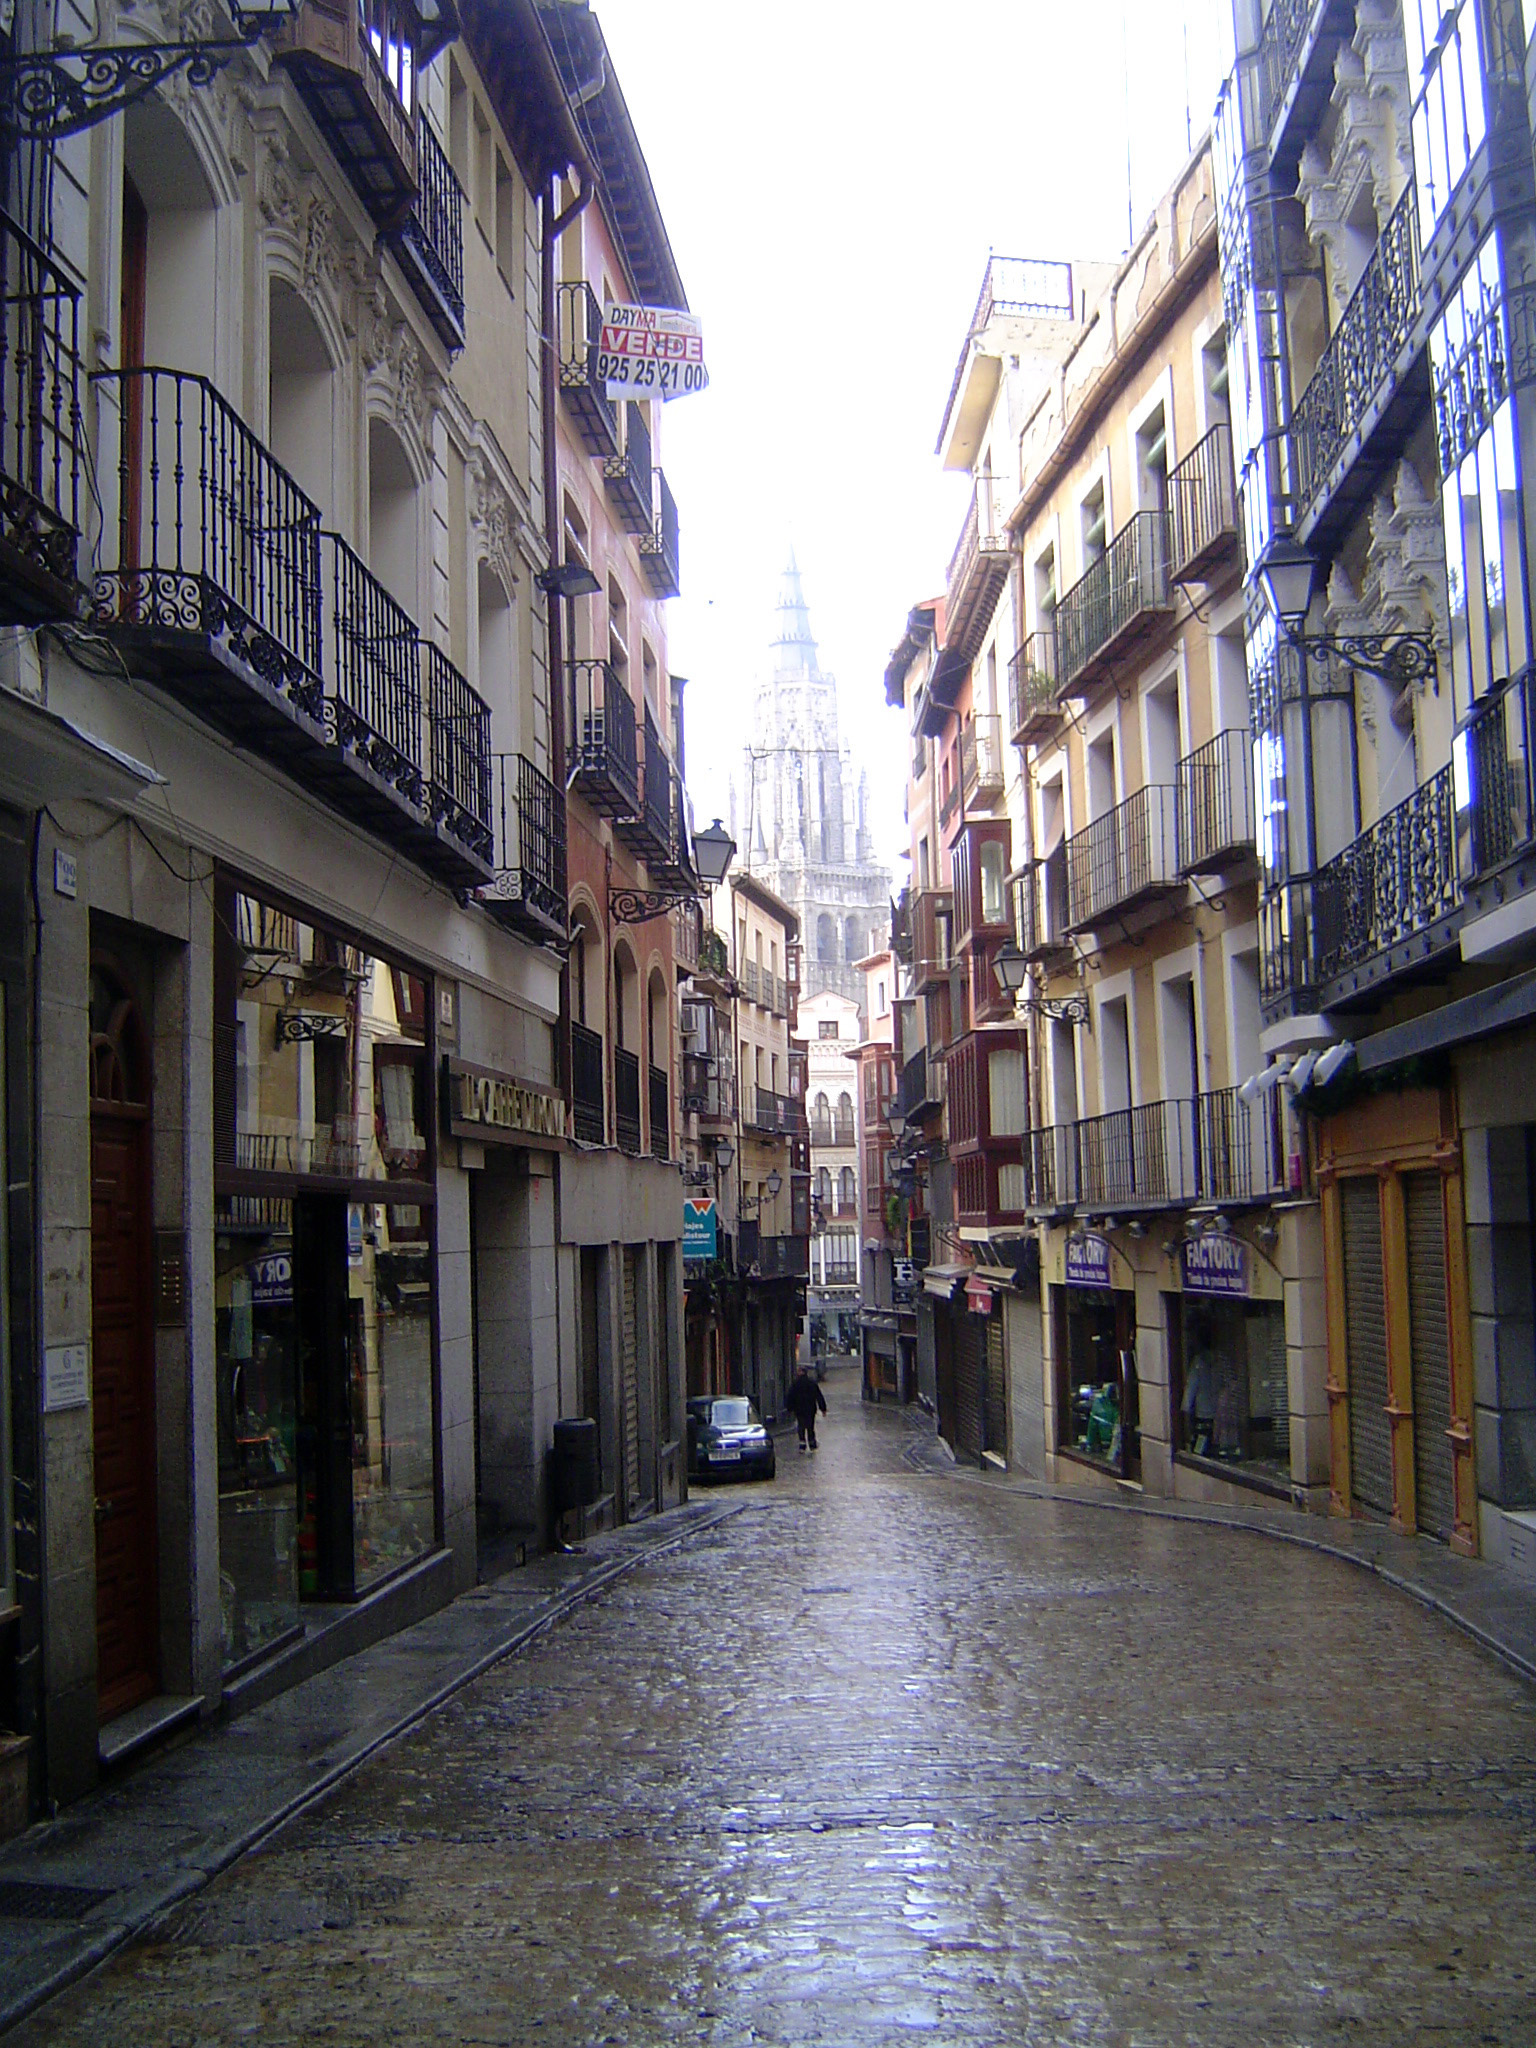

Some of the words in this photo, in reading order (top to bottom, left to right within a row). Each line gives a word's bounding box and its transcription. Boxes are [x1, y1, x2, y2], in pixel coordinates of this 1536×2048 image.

[611, 308, 656, 329] DAYMA
[605, 328, 701, 361] VENDE
[598, 354, 630, 383] 925
[634, 359, 656, 387] 25
[659, 361, 679, 389] 21
[684, 363, 703, 391] 00
[1068, 1239, 1105, 1265] FACTORY
[1186, 1238, 1242, 1270] FACTORY
